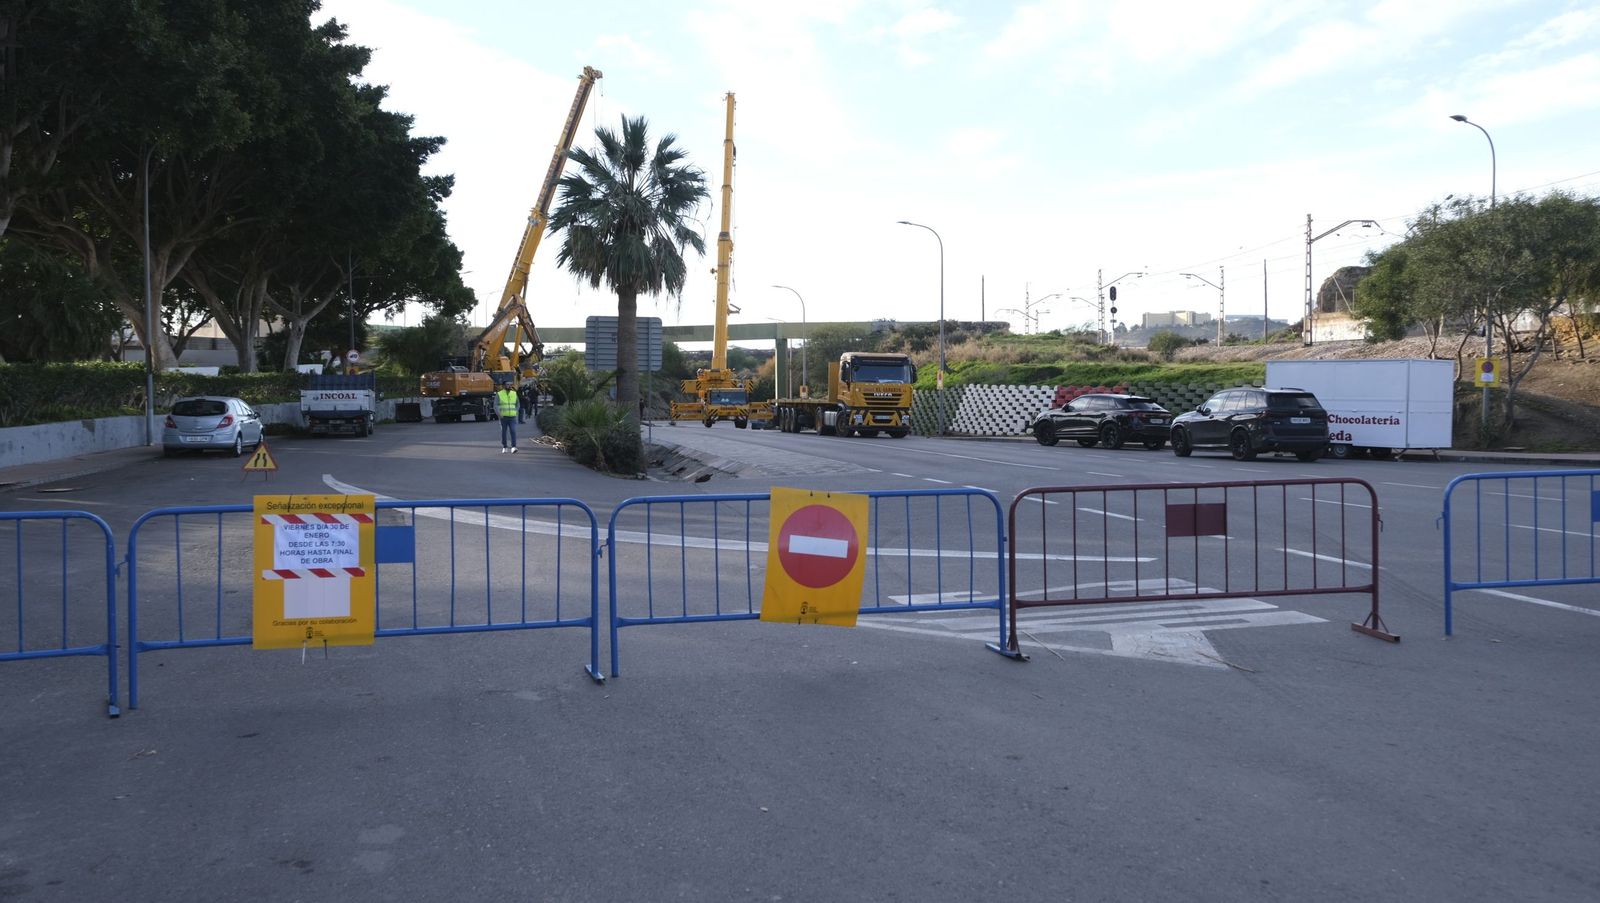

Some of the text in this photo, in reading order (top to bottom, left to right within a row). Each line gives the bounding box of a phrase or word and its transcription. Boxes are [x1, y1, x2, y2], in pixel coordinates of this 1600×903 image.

[320, 392, 357, 400] INCOAL
[1327, 414, 1400, 425] Chocolatería
[1329, 430, 1352, 442] eda
[266, 501, 365, 511] Señalización excepcional
[283, 523, 315, 531] VIERNES
